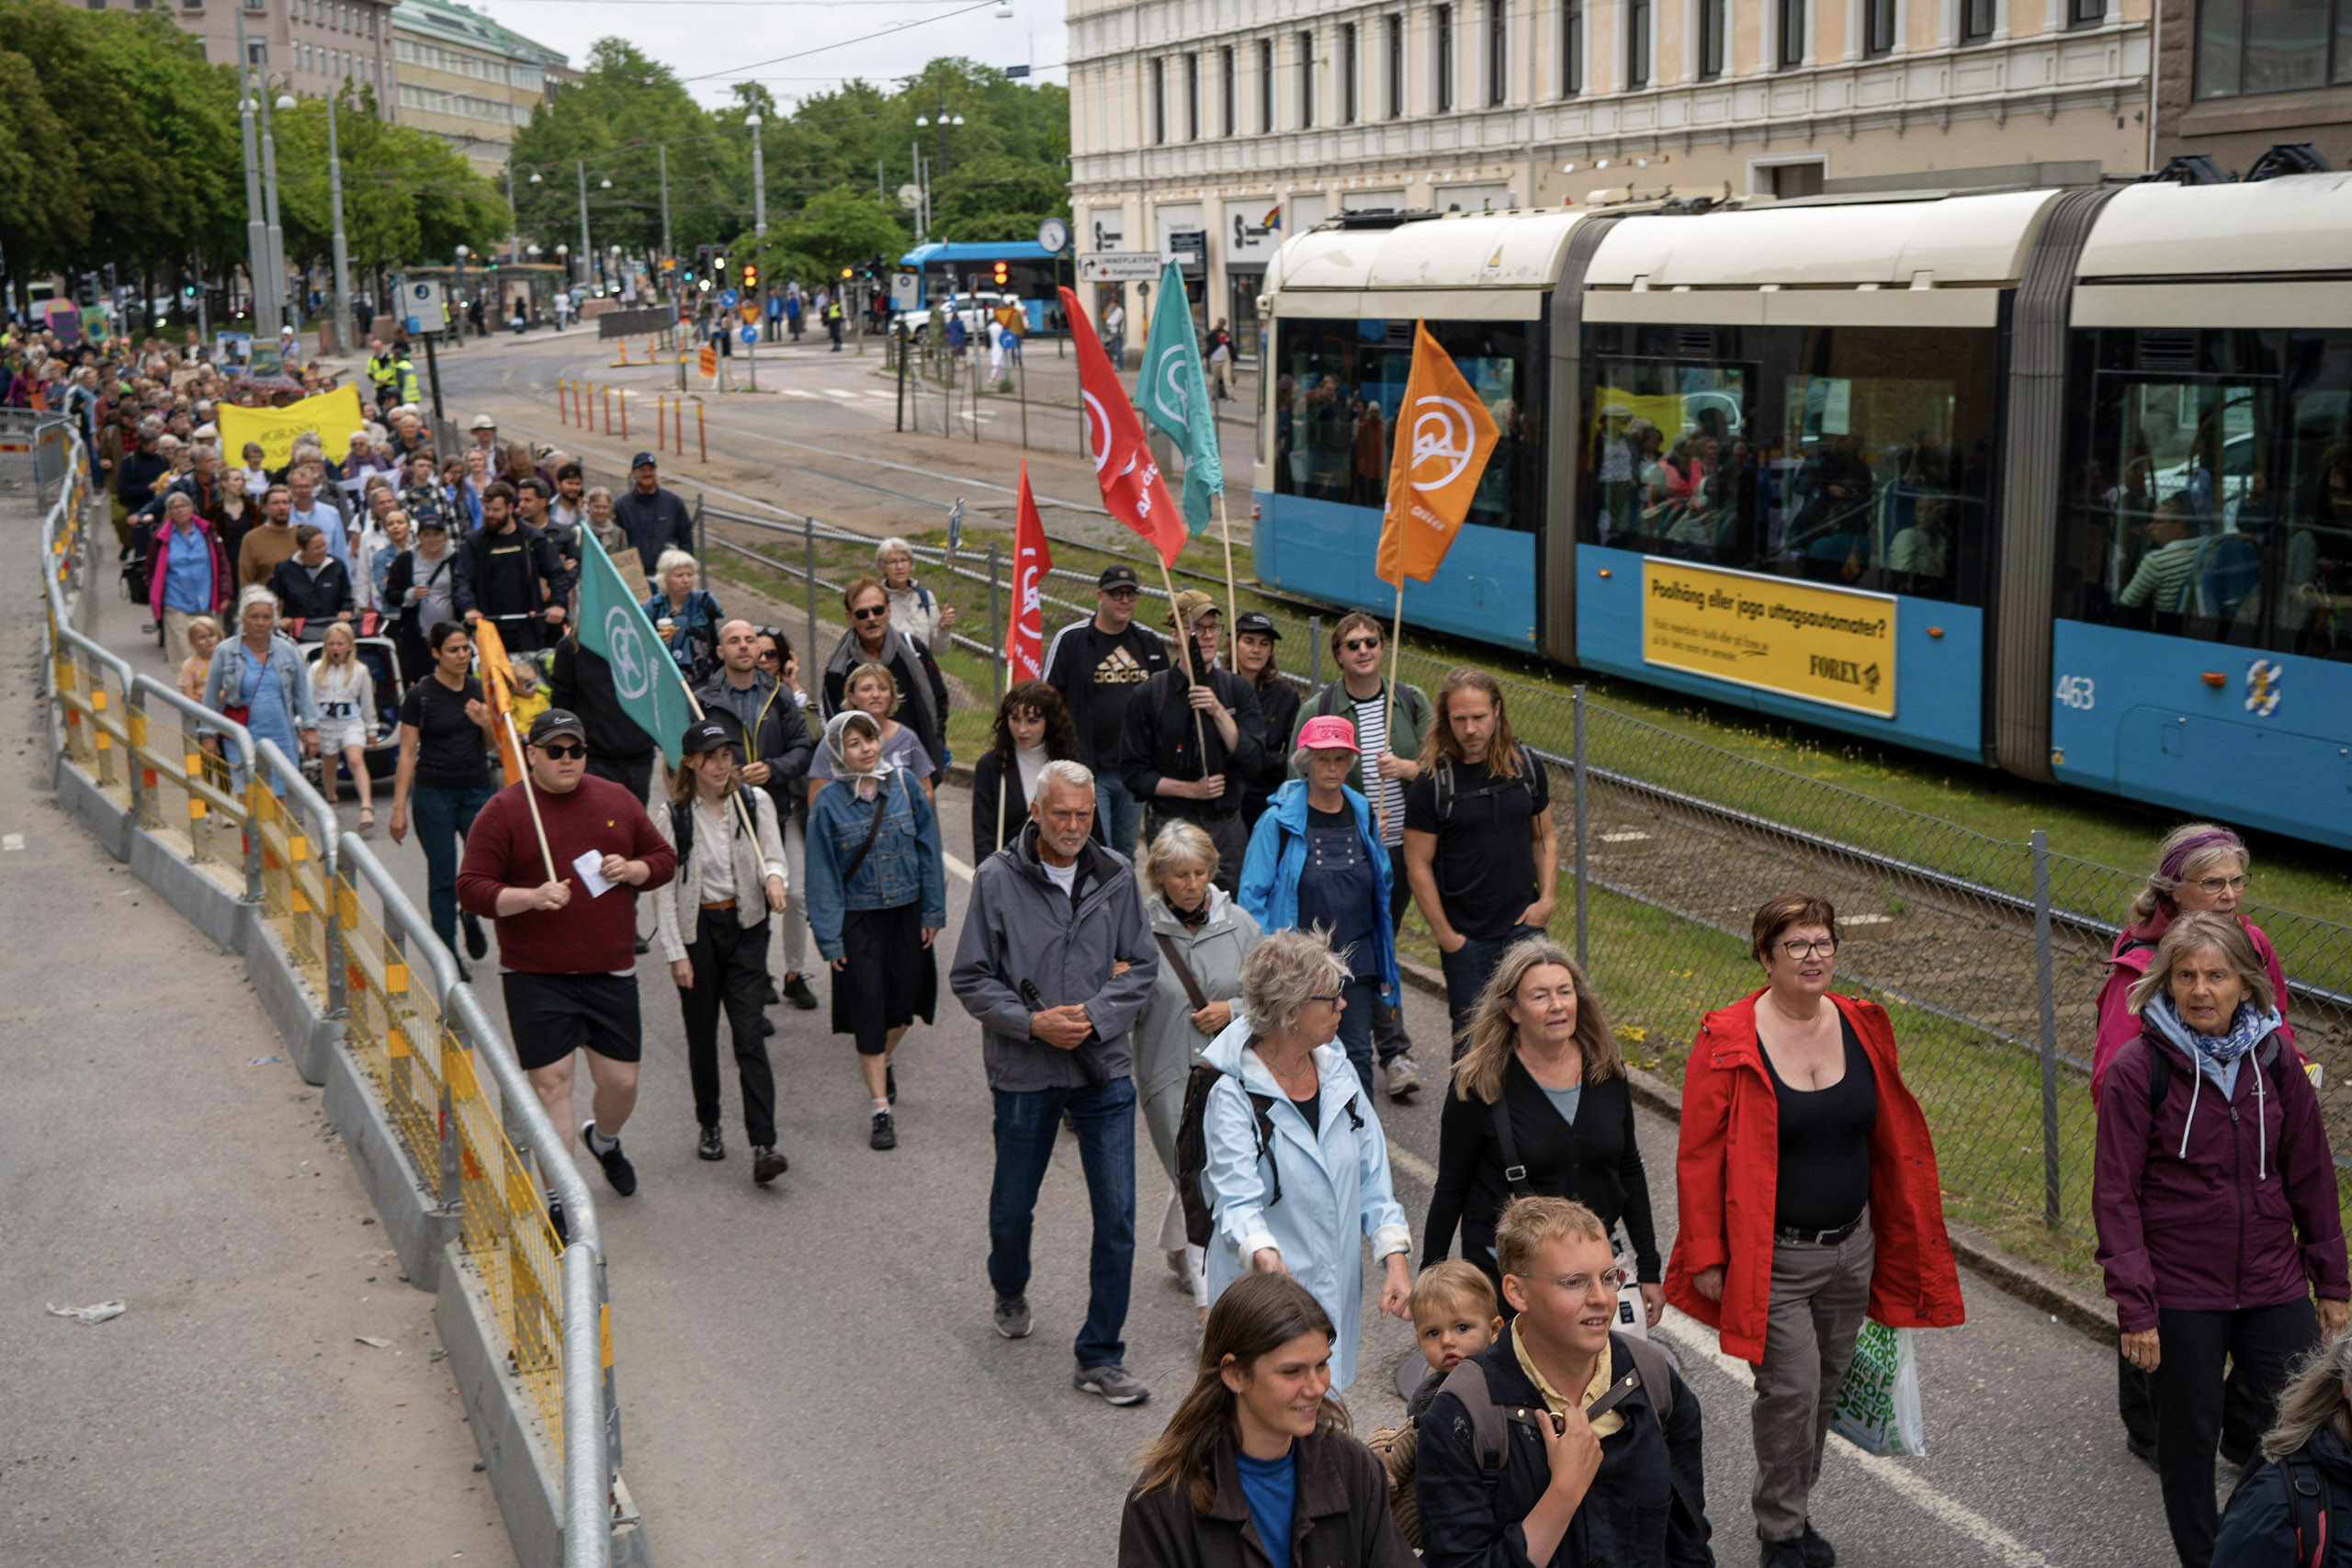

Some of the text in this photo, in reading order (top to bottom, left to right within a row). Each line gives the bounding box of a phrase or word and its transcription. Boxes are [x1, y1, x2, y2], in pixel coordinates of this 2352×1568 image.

[1652, 579, 1704, 611] Poolhäng
[1708, 589, 1735, 610] eller
[1736, 592, 1765, 621] jaga
[1768, 604, 1887, 639] uttagsautomater?
[1093, 667, 1150, 683] adidas
[1809, 653, 1860, 685] FOREX
[2055, 674, 2095, 710] 463
